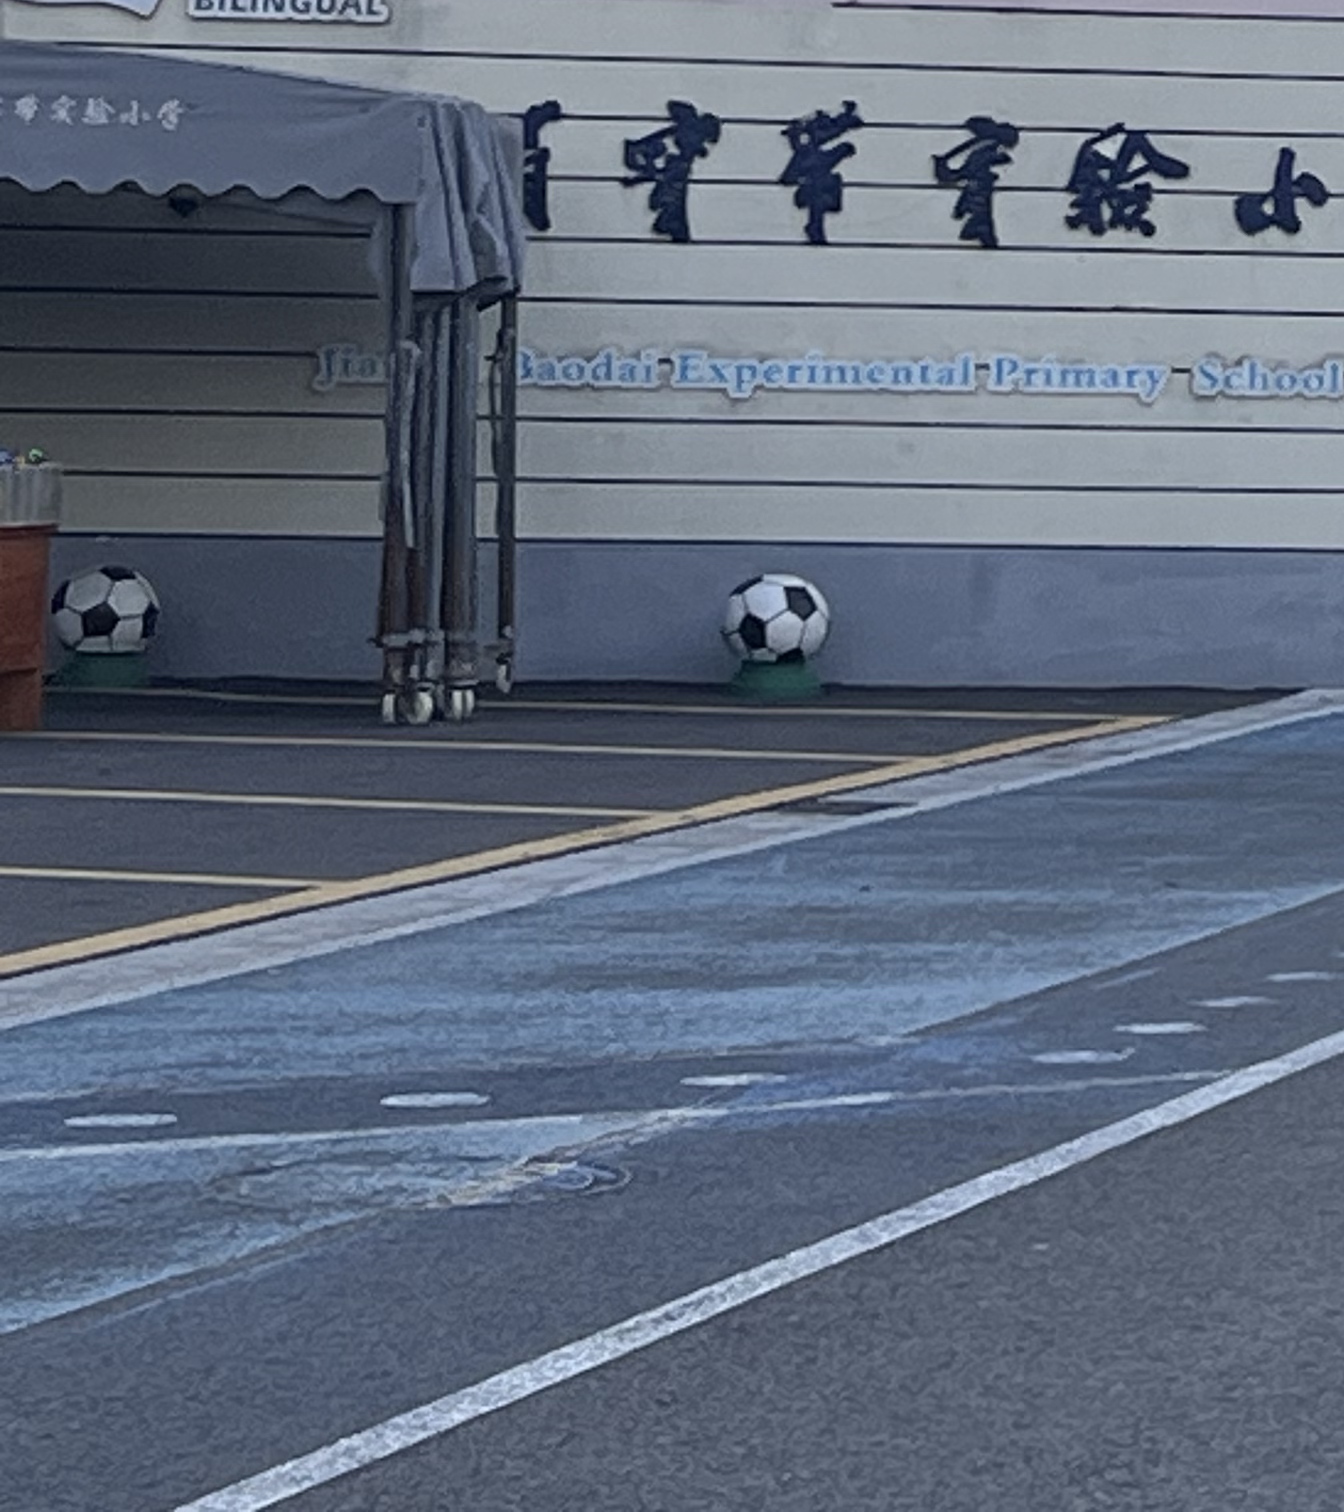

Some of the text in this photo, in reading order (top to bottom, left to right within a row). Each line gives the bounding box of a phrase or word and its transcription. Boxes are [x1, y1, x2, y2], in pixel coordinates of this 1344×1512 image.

[676, 354, 972, 392] Experimental
[996, 357, 1162, 394] Primary
[1199, 362, 1341, 391] School
